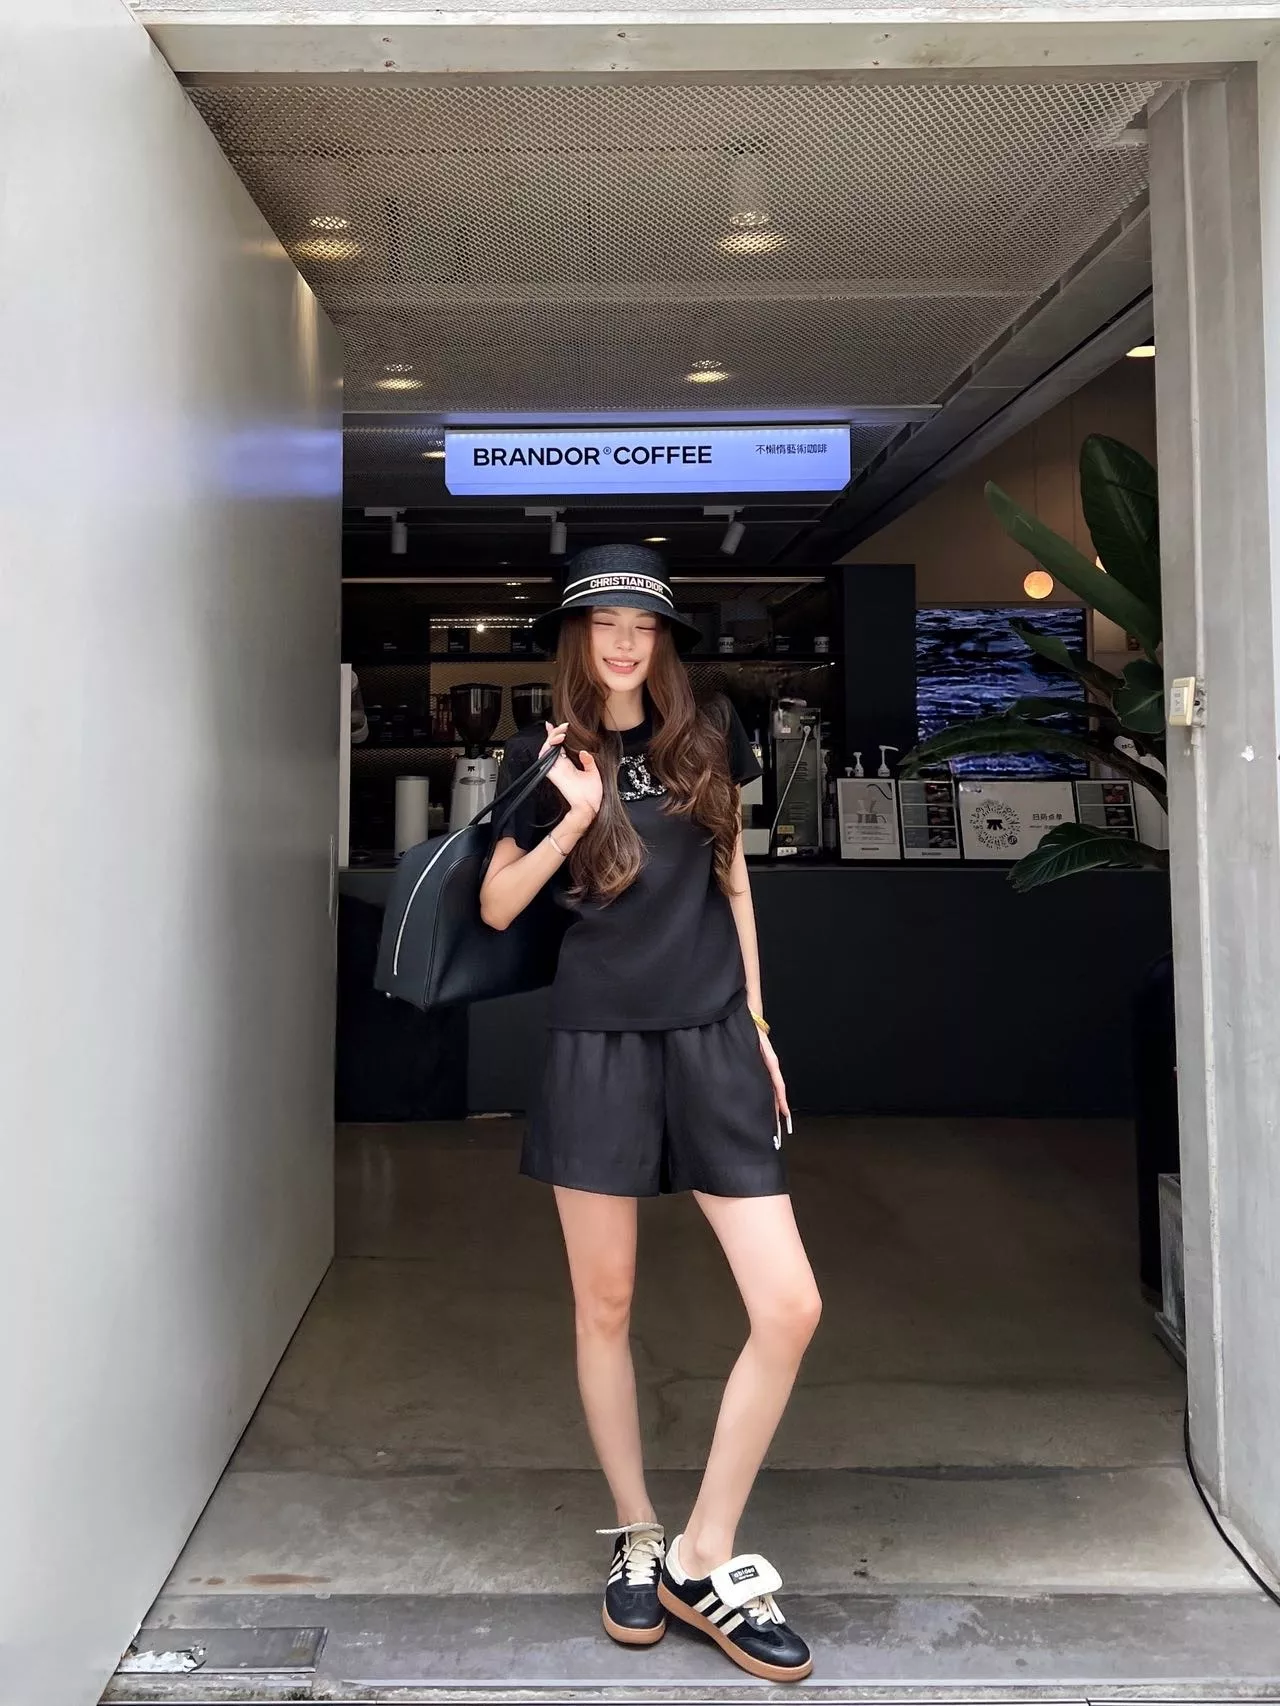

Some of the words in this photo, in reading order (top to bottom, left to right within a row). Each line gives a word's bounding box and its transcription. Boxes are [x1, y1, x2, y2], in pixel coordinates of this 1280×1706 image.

[613, 445, 713, 465] COFFEE
[590, 576, 644, 588] CHRISTIAN
[645, 580, 664, 594] DIOR
